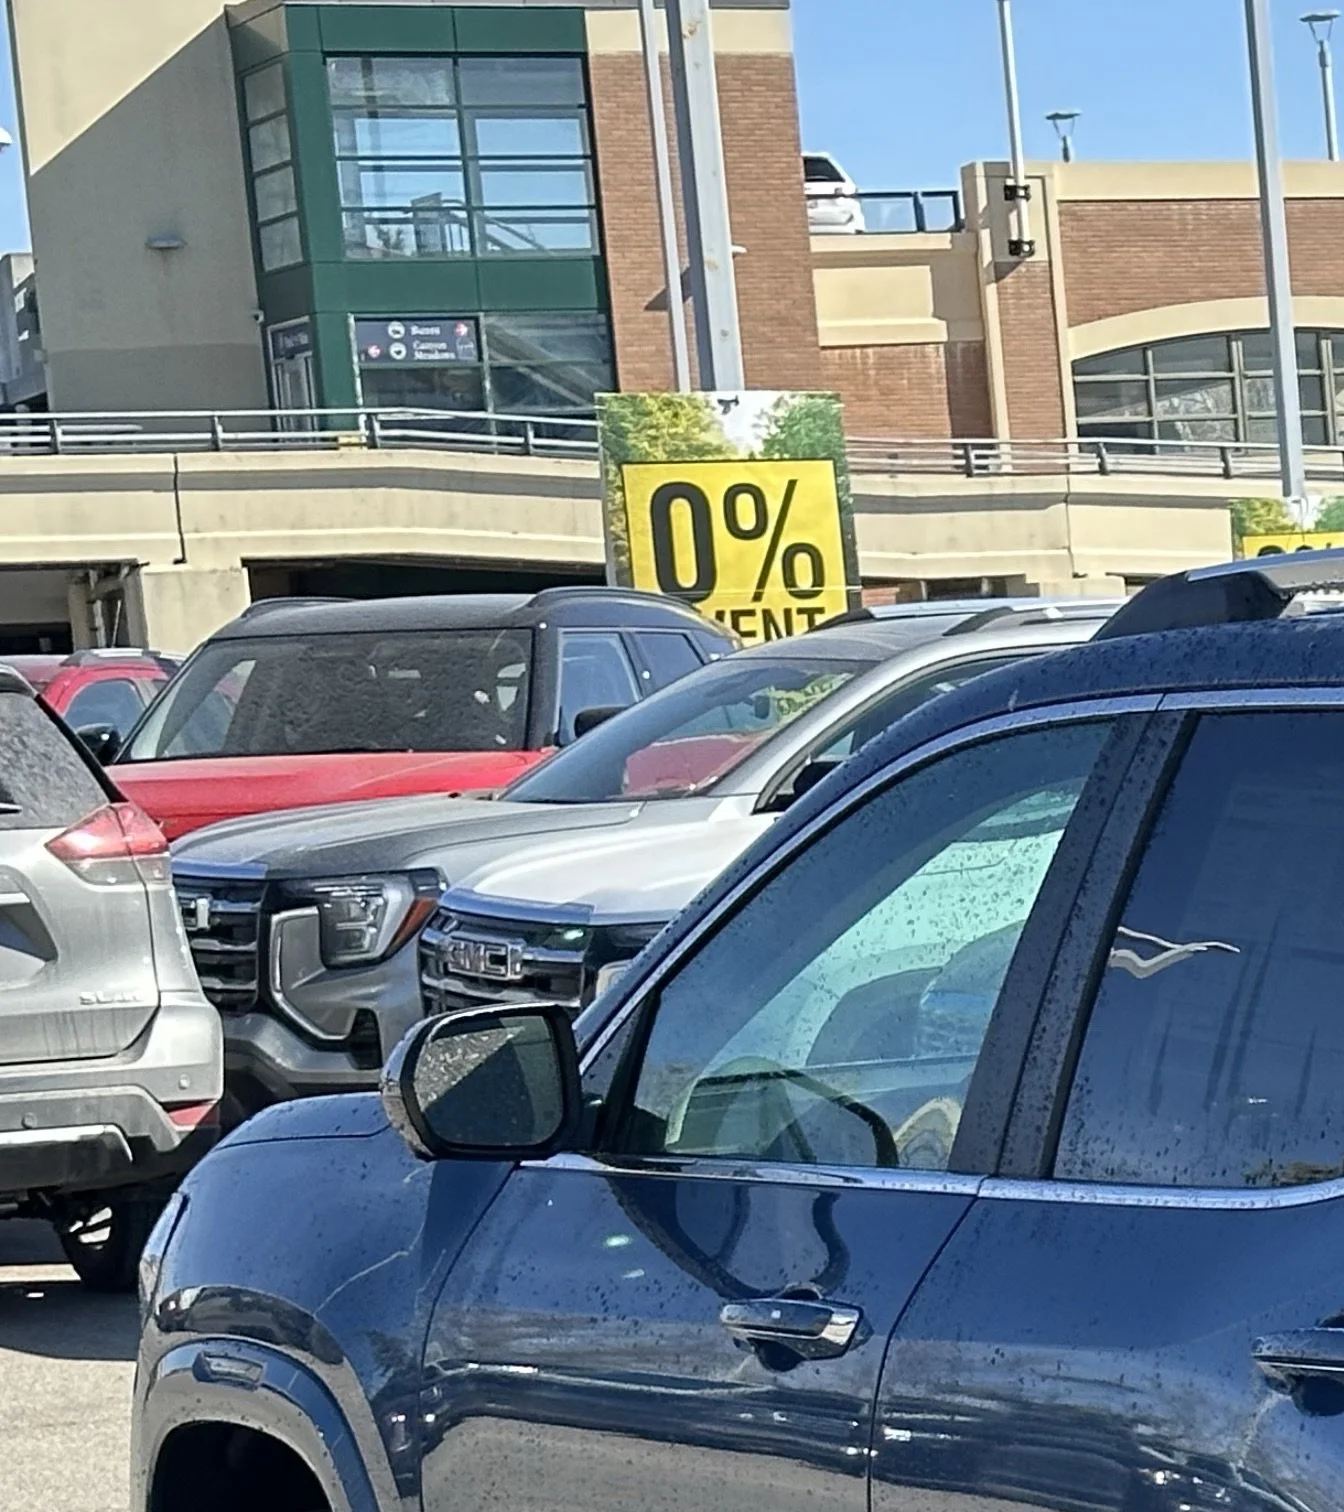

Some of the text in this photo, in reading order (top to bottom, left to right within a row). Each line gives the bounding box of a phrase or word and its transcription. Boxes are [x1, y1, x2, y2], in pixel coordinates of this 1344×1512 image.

[650, 478, 826, 603] 0%
[714, 606, 826, 642] ENT
[446, 938, 511, 979] GMC
